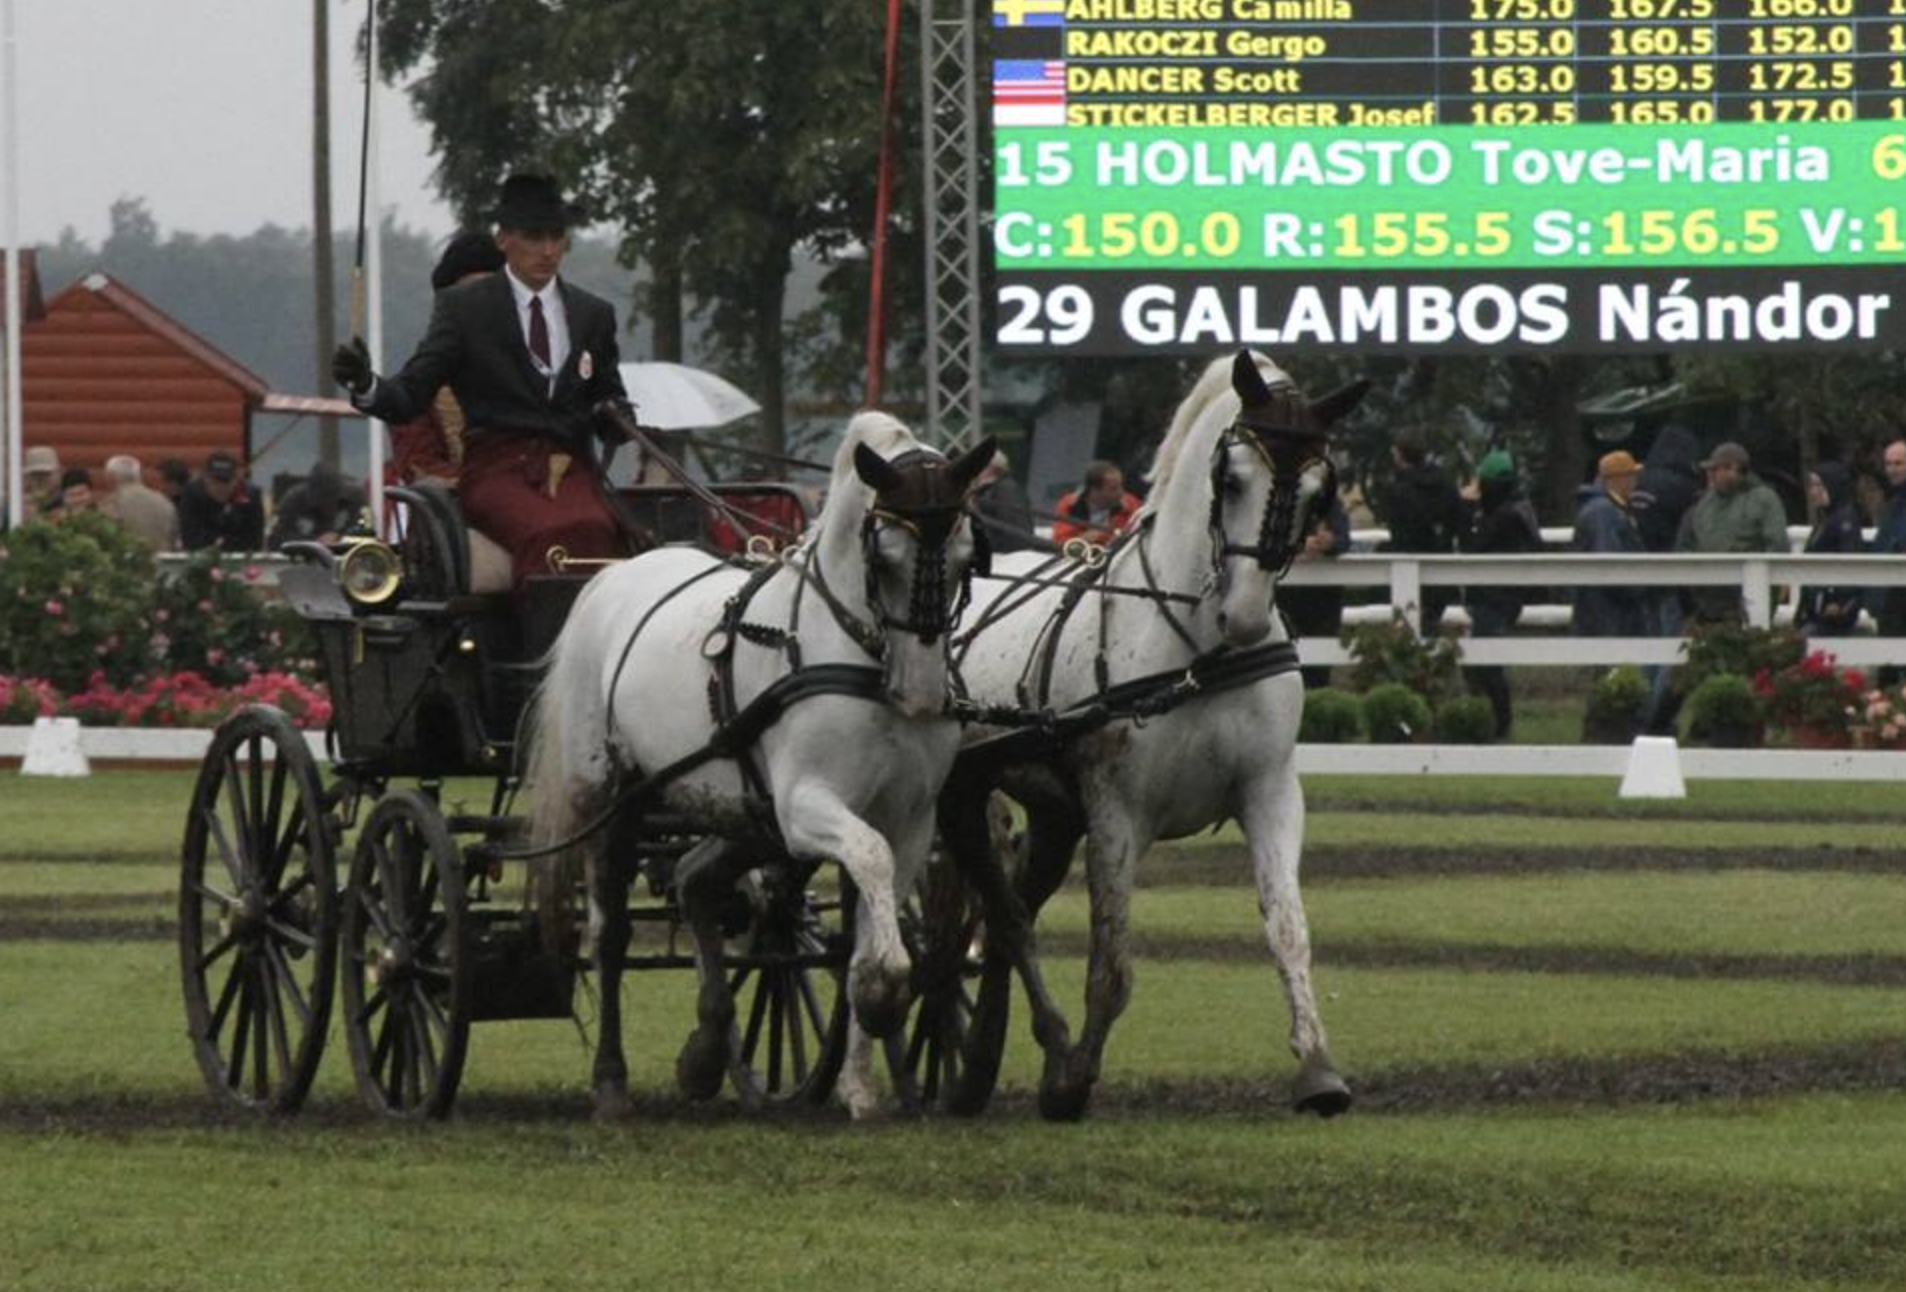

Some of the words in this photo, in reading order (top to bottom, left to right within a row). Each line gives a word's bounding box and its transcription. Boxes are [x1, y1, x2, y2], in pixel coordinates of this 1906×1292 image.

[1066, 0, 1222, 19] AHLBERG
[1232, 0, 1352, 19] Camilla
[1470, 0, 1574, 19] 175.0
[1610, 0, 1713, 18] 167.5
[1067, 31, 1217, 55] RAKOCZI
[1226, 31, 1326, 61] Gergo
[1470, 29, 1575, 56] 155.0
[1610, 28, 1713, 55] 160.5
[1748, 26, 1853, 54] 152.0
[1067, 68, 1204, 92] DANCER
[1214, 67, 1300, 92] Scott
[1470, 65, 1575, 92] 163.0
[1610, 64, 1713, 91] 159.5
[1749, 62, 1853, 90] 172.5
[1067, 104, 1338, 126] STICKELBERGER
[1347, 102, 1436, 126] Josef
[1470, 102, 1576, 125] 162.5
[1611, 101, 1713, 124] 165.0
[1749, 99, 1853, 122] 177.0
[998, 142, 1073, 185] 15
[1099, 140, 1452, 186] HOLMASTO
[1471, 136, 1830, 184] Tove-Maria
[993, 212, 1241, 257] C:150.0
[1264, 212, 1512, 257] R:155.5
[1533, 209, 1779, 255] S:156.5
[997, 285, 1094, 344] 29
[1121, 284, 1569, 345] GALAMBOS
[1599, 278, 1891, 342] Nándor
